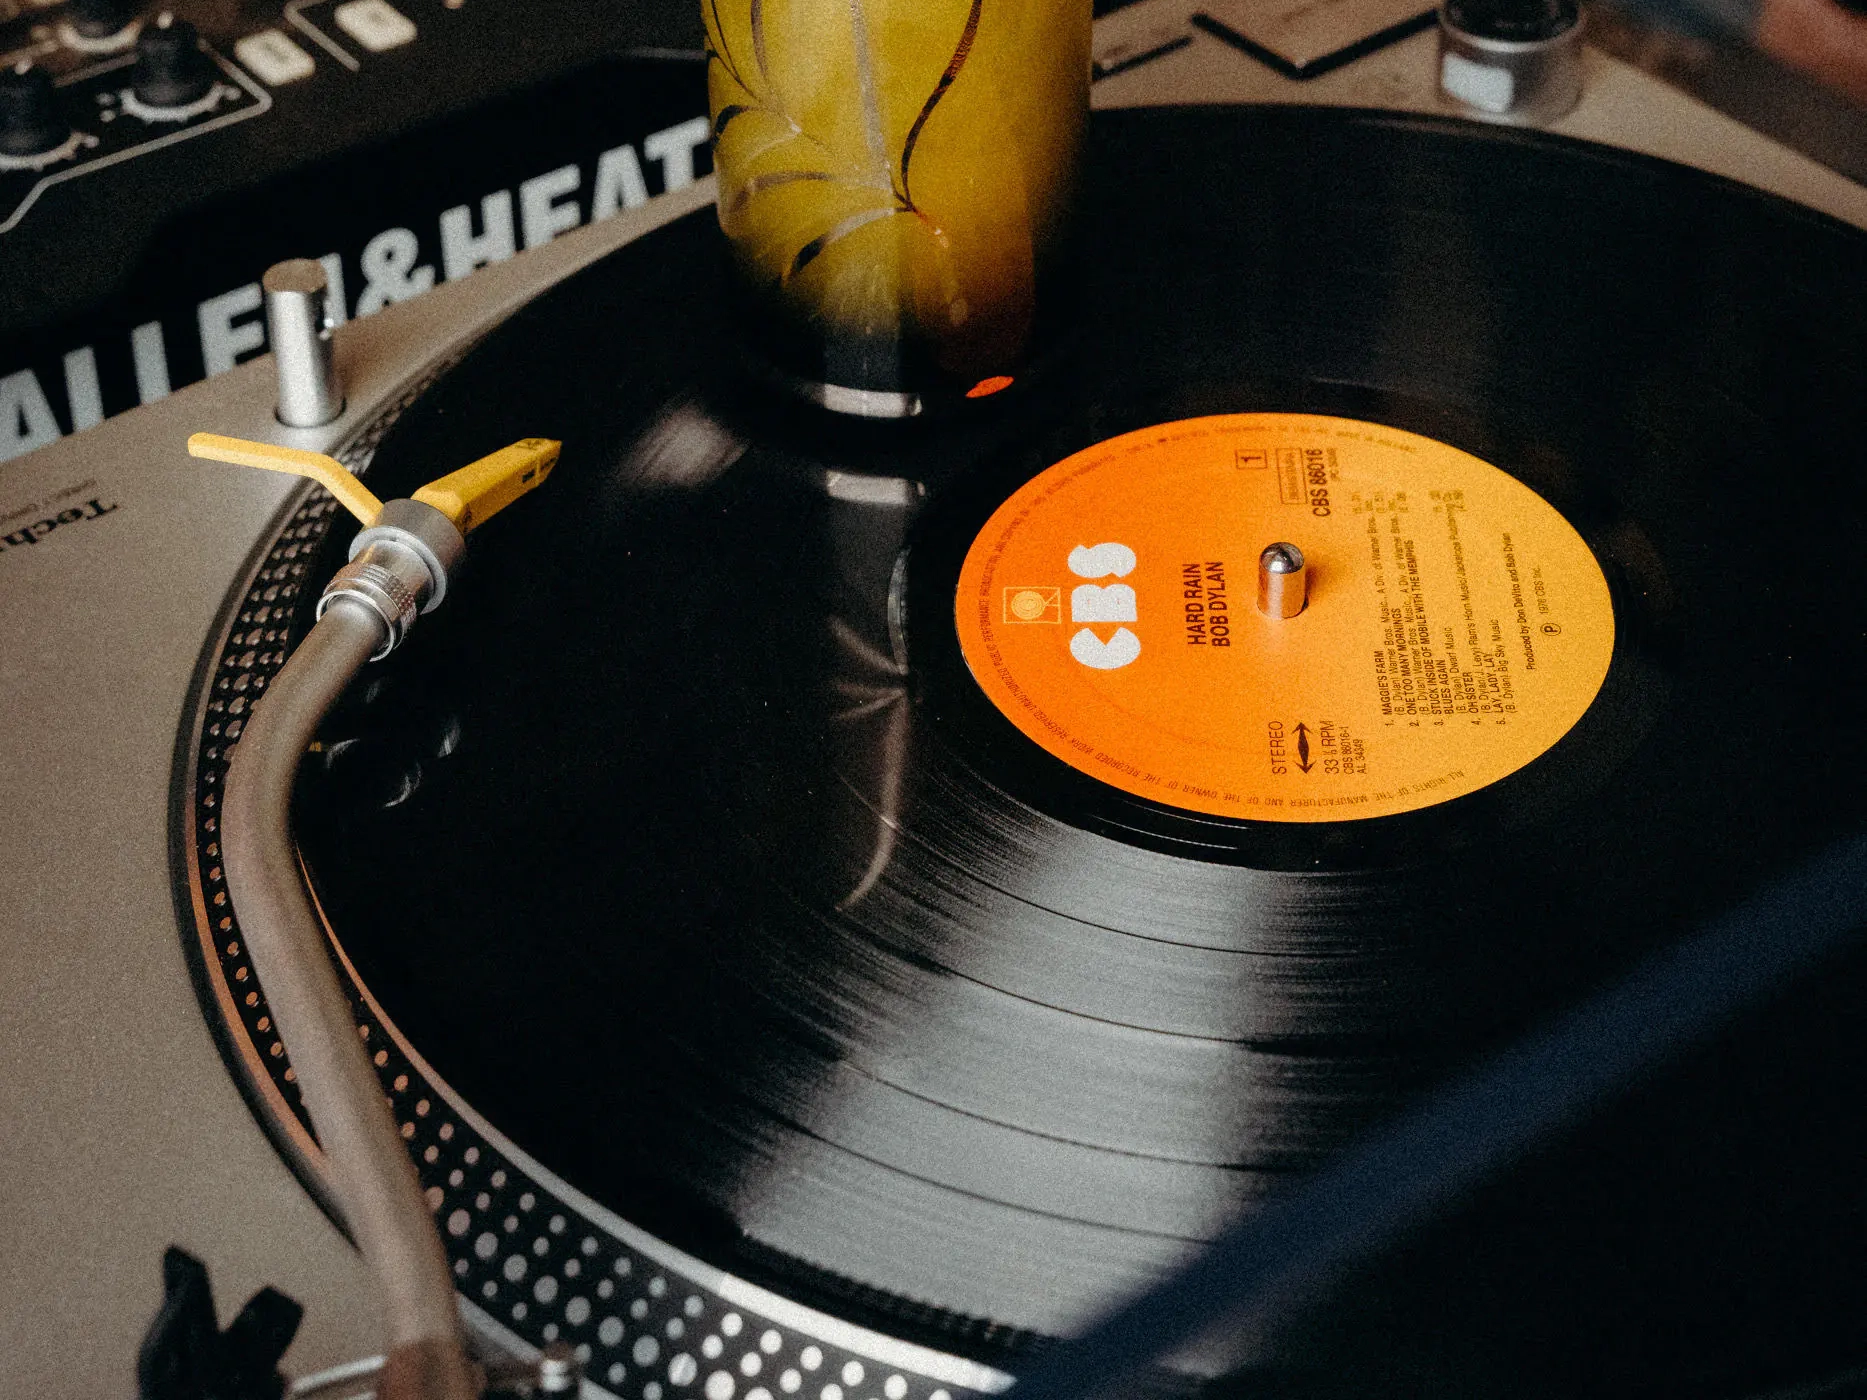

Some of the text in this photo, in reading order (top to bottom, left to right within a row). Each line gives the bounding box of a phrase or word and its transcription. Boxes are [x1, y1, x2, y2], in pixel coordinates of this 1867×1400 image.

[1306, 449, 1330, 517] CBS 86016
[0, 499, 117, 552] Tech
[1403, 540, 1418, 574] MEMPHIS
[1410, 577, 1421, 591] THE
[1533, 580, 1545, 597] CBS
[1067, 542, 1141, 670] CBS
[1182, 563, 1207, 645] HARD RAIN
[1205, 561, 1230, 647] BOB DYLAN
[1412, 593, 1425, 613] WITH
[1463, 603, 1473, 620] Horn
[1501, 532, 1536, 670] Produced by Don DeVito and Bob Dylan
[1384, 627, 1394, 645] Bros.
[1391, 608, 1406, 651] MORNINGS
[1415, 615, 1430, 645] MOBILE
[1444, 627, 1454, 650] Music
[1467, 623, 1478, 646] Ram's
[1489, 620, 1501, 641] Music
[1374, 651, 1386, 673] FARM
[1387, 649, 1398, 674] Warner
[1412, 648, 1423, 674] Warner
[1421, 647, 1432, 658] OF
[1446, 652, 1459, 673] Dwarf
[1483, 653, 1494, 667] LAY
[1494, 645, 1505, 658] Sky
[1399, 653, 1411, 676] MANY
[1423, 660, 1437, 686] INSIDE
[1497, 660, 1508, 672] Big
[1378, 676, 1392, 715] MAGGIE'S
[1402, 678, 1414, 696] TOO
[1436, 660, 1454, 714] BLUES AGAIN
[1451, 676, 1465, 700] Dylan)
[1405, 698, 1417, 715] ONE
[1430, 688, 1442, 715] STUCK
[1462, 672, 1481, 726] 4. OH SISTER
[1320, 720, 1336, 746] RPM
[1071, 738, 1093, 754] WORK
[1268, 721, 1287, 774] STEREO
[1339, 726, 1354, 774] CBS 86016-1
[1095, 752, 1139, 777] RECORDED
[1357, 763, 1367, 774] AL
[1143, 773, 1161, 785] THE
[1183, 784, 1217, 800] OWNER
[1223, 793, 1241, 803] THE
[1247, 796, 1259, 805] OF
[1264, 798, 1284, 806] AND
[1290, 795, 1368, 807] MANUFACTURER
[1375, 790, 1393, 801] THE
